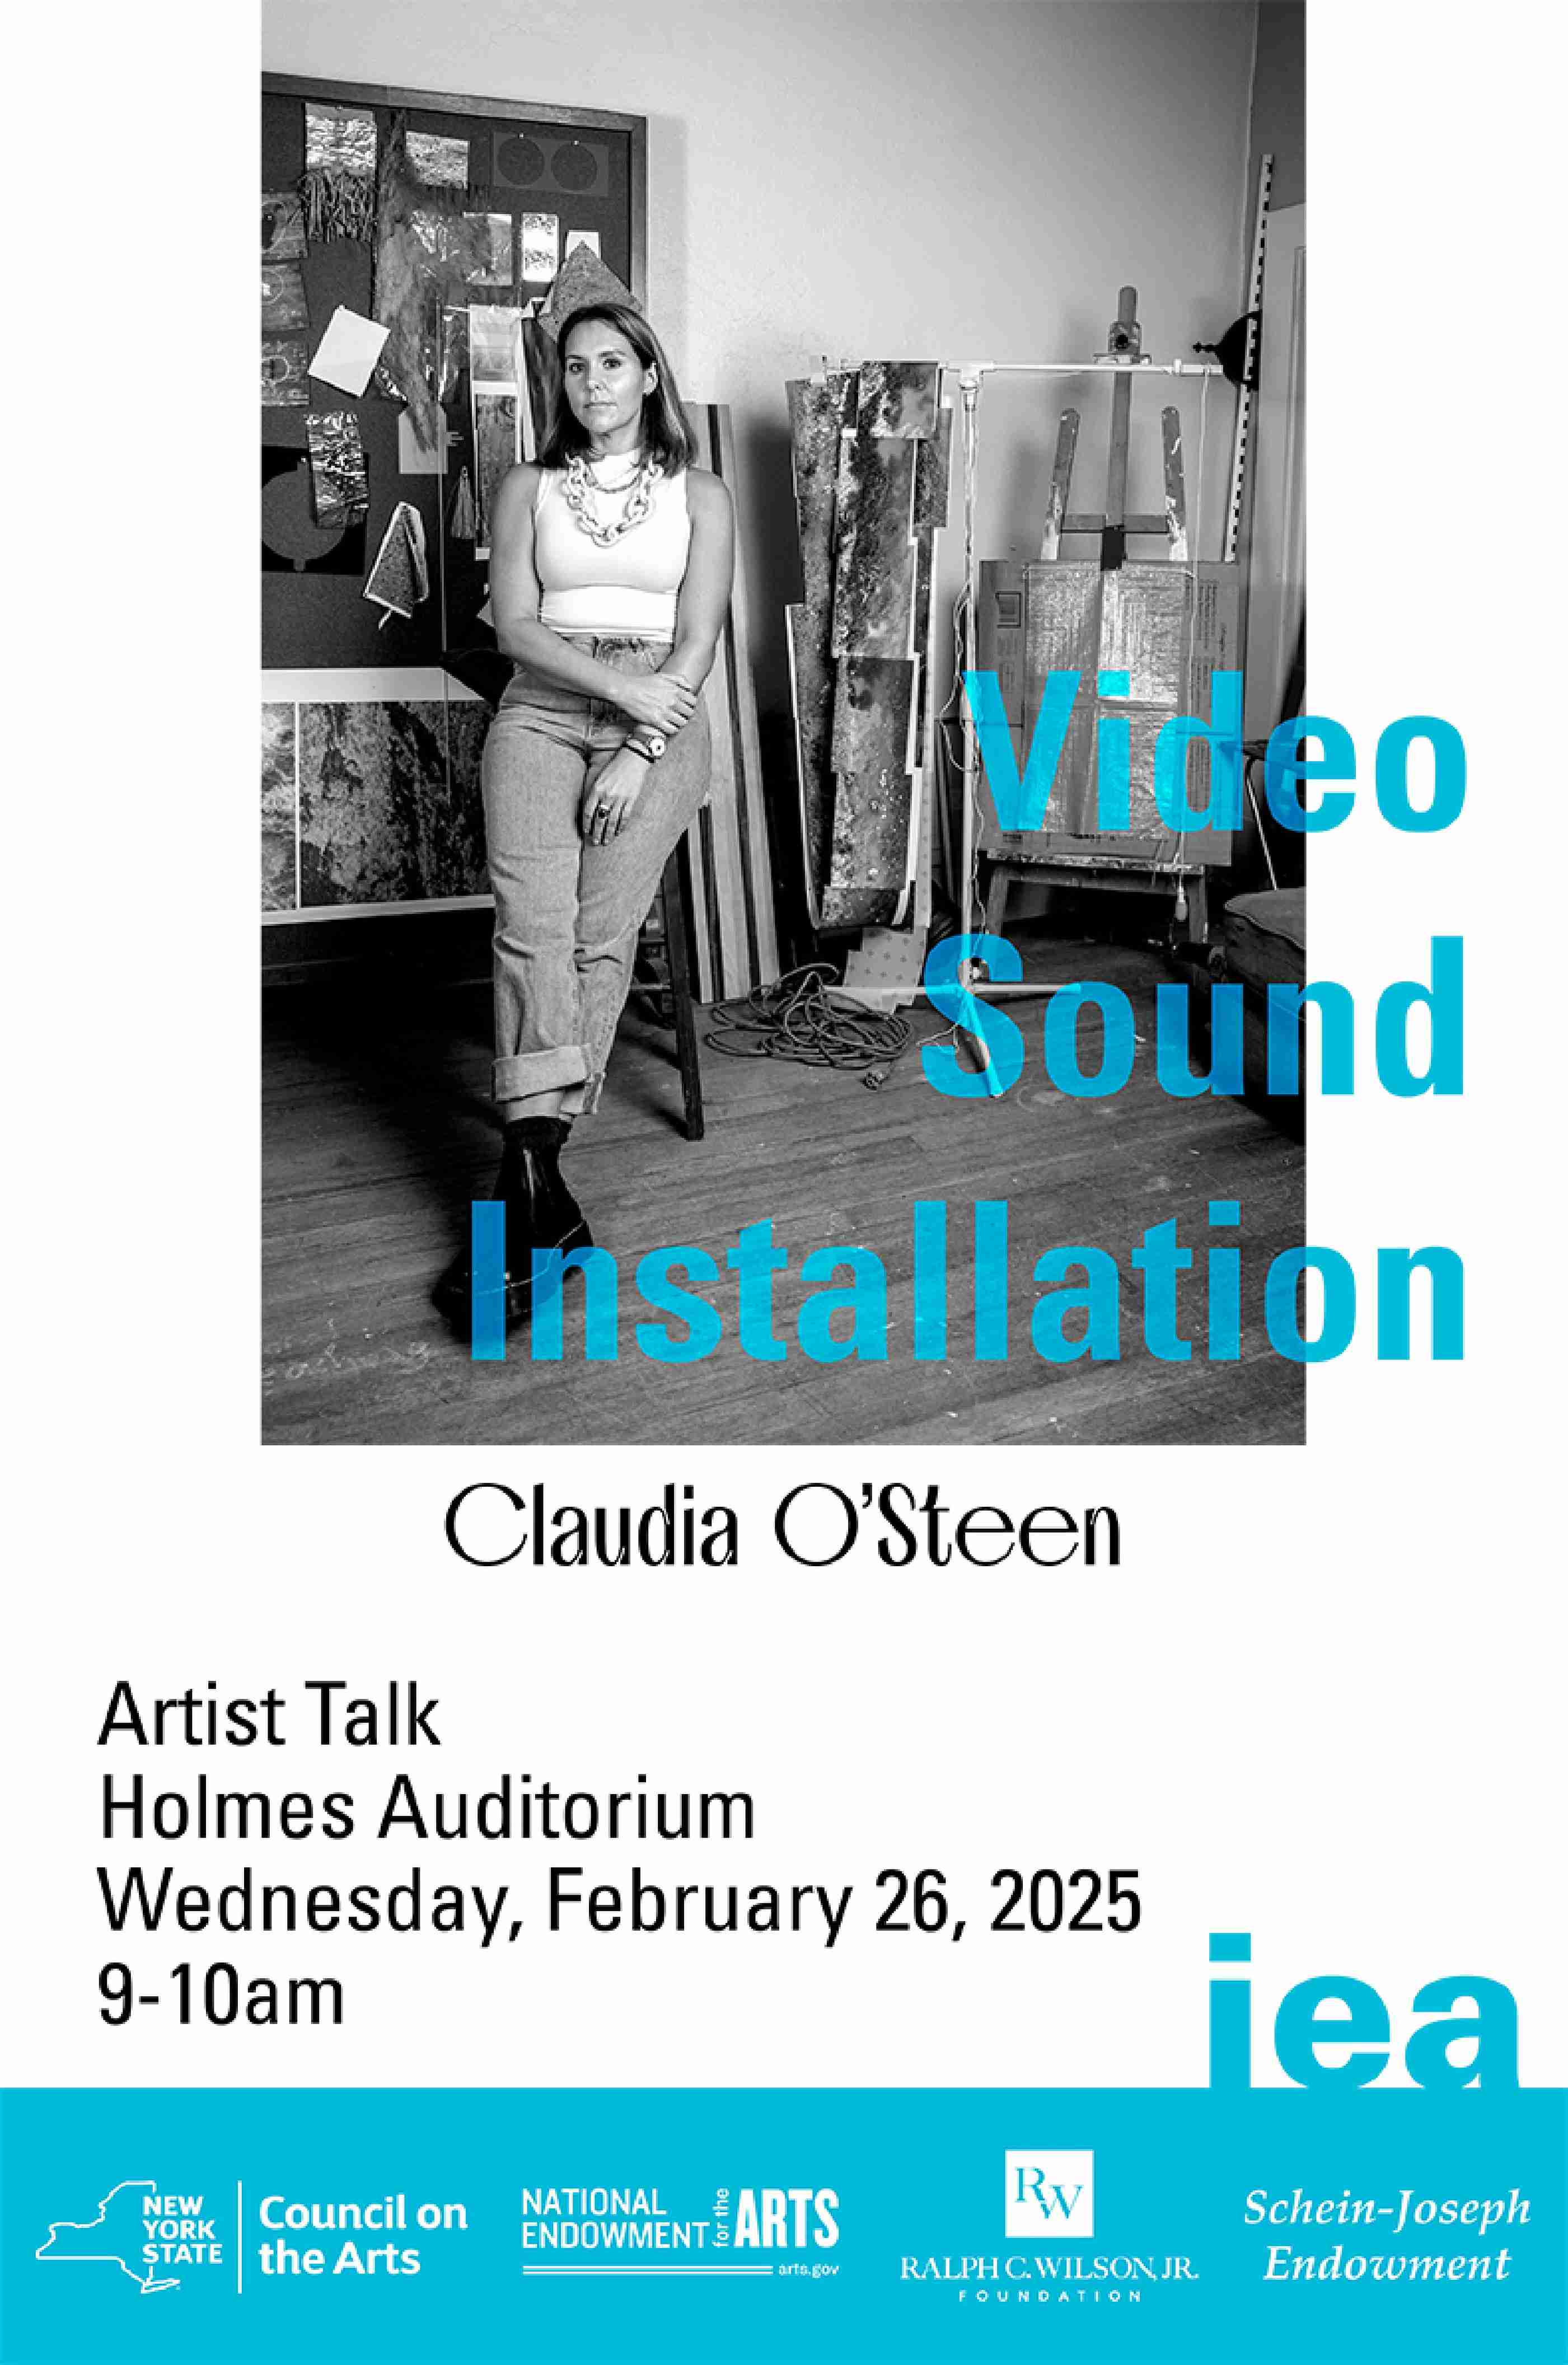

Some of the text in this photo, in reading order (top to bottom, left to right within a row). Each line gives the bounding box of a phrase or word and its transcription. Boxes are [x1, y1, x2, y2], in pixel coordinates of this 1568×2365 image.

[962, 671, 1466, 833] Video
[922, 933, 1463, 1098] Sound
[471, 1200, 1463, 1363] Installation
[446, 1483, 737, 1566] Claudia
[97, 1681, 440, 1746] Artist Talk
[104, 1774, 753, 1839] Holmes Auditorium
[97, 1867, 1140, 1947] Wednesday, February 26, 2025
[99, 1963, 341, 2024] 9-10am
[1209, 1933, 1519, 2087] iea
[143, 2197, 203, 2216] NEW
[260, 2194, 467, 2228] Council on
[523, 2188, 666, 2215] NATIONAL
[712, 2189, 729, 2247] for the
[734, 2189, 839, 2248] ARTS
[1245, 2189, 1530, 2235] Schein-Joseph
[143, 2220, 215, 2240] YORK
[523, 2222, 710, 2248] ENDOWMENT
[143, 2244, 222, 2264] STATE
[259, 2239, 420, 2274] the Arts
[779, 2264, 839, 2278] arts.gov
[902, 2258, 1198, 2282] RALPH C. WILSON, JR.
[1264, 2246, 1511, 2280] Endowment
[959, 2290, 1140, 2302] FOUNDATION
